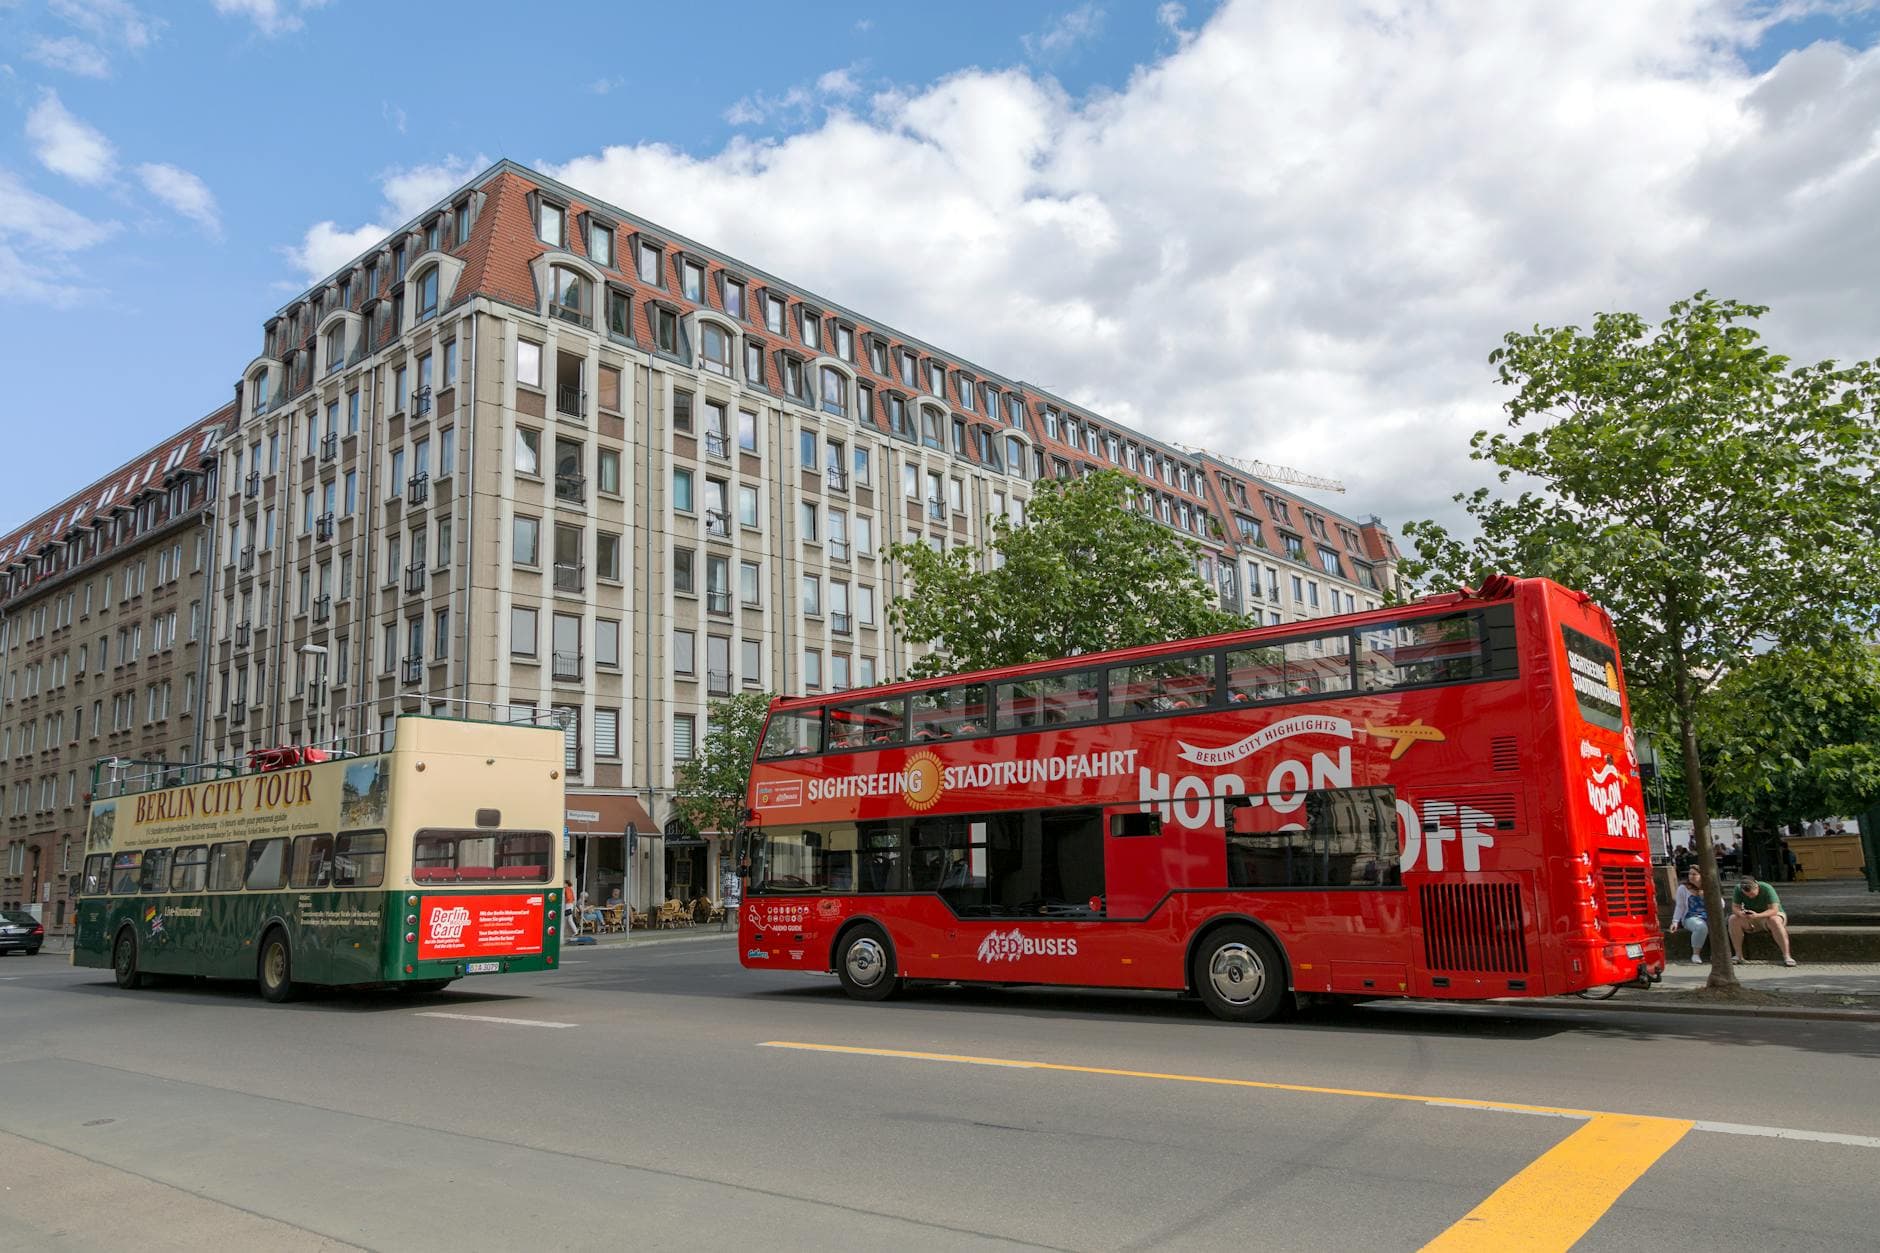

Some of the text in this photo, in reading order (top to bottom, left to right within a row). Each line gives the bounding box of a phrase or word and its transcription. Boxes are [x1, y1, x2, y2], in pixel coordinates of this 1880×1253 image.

[1196, 720, 1337, 763] BERLIN CITY HIGHLIGHTS
[808, 749, 1138, 800] SIGHTSEEING STADTRUNDFAHRT
[135, 769, 313, 826] BERLIN CITY TOUR
[432, 908, 468, 923] Berlin
[433, 923, 461, 937] Card
[988, 938, 1078, 956] RED BUSES
